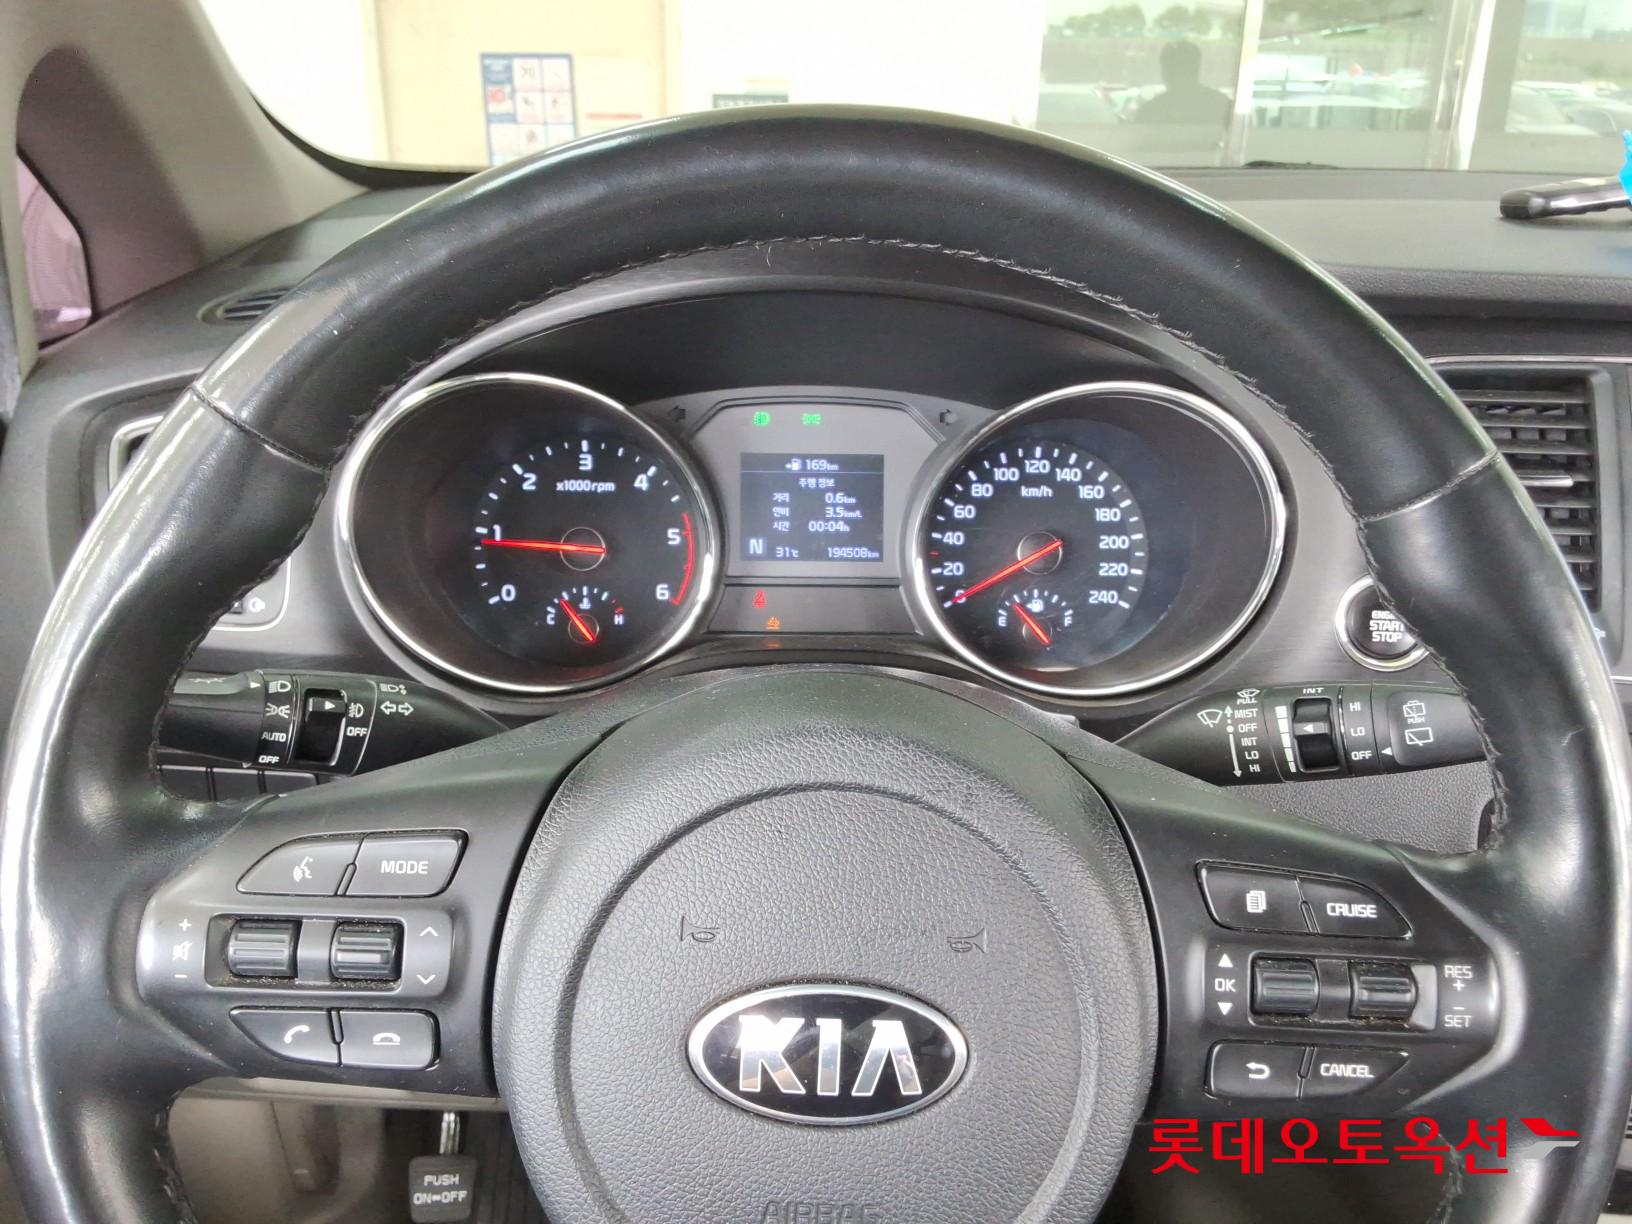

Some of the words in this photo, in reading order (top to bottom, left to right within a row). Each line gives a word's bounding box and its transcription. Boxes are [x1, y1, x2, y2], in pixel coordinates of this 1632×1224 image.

[579, 454, 593, 471] 3
[1024, 460, 1050, 473] 120
[993, 468, 1019, 481] 100
[1055, 468, 1081, 482] 140
[522, 473, 537, 490] 2
[634, 474, 648, 491] 4
[971, 484, 993, 497] 80
[1021, 486, 1053, 497] km/h
[1078, 485, 1105, 498] 160
[772, 492, 790, 503] 거리
[772, 506, 790, 518] 연비
[953, 505, 976, 518] 60
[1095, 508, 1121, 521] 180
[492, 524, 502, 541] 1
[772, 521, 791, 532] 시간
[667, 528, 681, 545] 5
[943, 532, 964, 545] 40
[1099, 536, 1129, 549] 200
[749, 538, 763, 555] N
[943, 562, 964, 575] 20
[1099, 562, 1129, 576] 220
[501, 584, 516, 601] 0
[655, 584, 669, 600] 6
[1089, 591, 1118, 604] 240
[547, 614, 555, 625] C
[614, 614, 624, 625] H
[998, 616, 1007, 627] E
[1064, 616, 1072, 627] F
[1371, 630, 1402, 642] STOP
[1349, 701, 1361, 712] HI
[1234, 708, 1258, 719] MIST
[346, 726, 368, 737] OFF
[1238, 723, 1258, 733] OFF
[1350, 726, 1365, 737] LO
[261, 731, 287, 743] AUTO
[1241, 736, 1258, 746] INT
[258, 754, 279, 764] OFF
[1244, 750, 1259, 760] LO
[1351, 750, 1373, 760] OFF
[1249, 763, 1261, 773] HI
[380, 860, 429, 875] MODE
[1326, 902, 1378, 918] CRUISE
[1444, 965, 1473, 979] RES
[1214, 978, 1236, 992] OK
[1444, 1015, 1472, 1028] SET
[735, 1014, 923, 1097] KIA
[1320, 1063, 1375, 1078] CANCEL
[424, 1174, 460, 1187] PUSH
